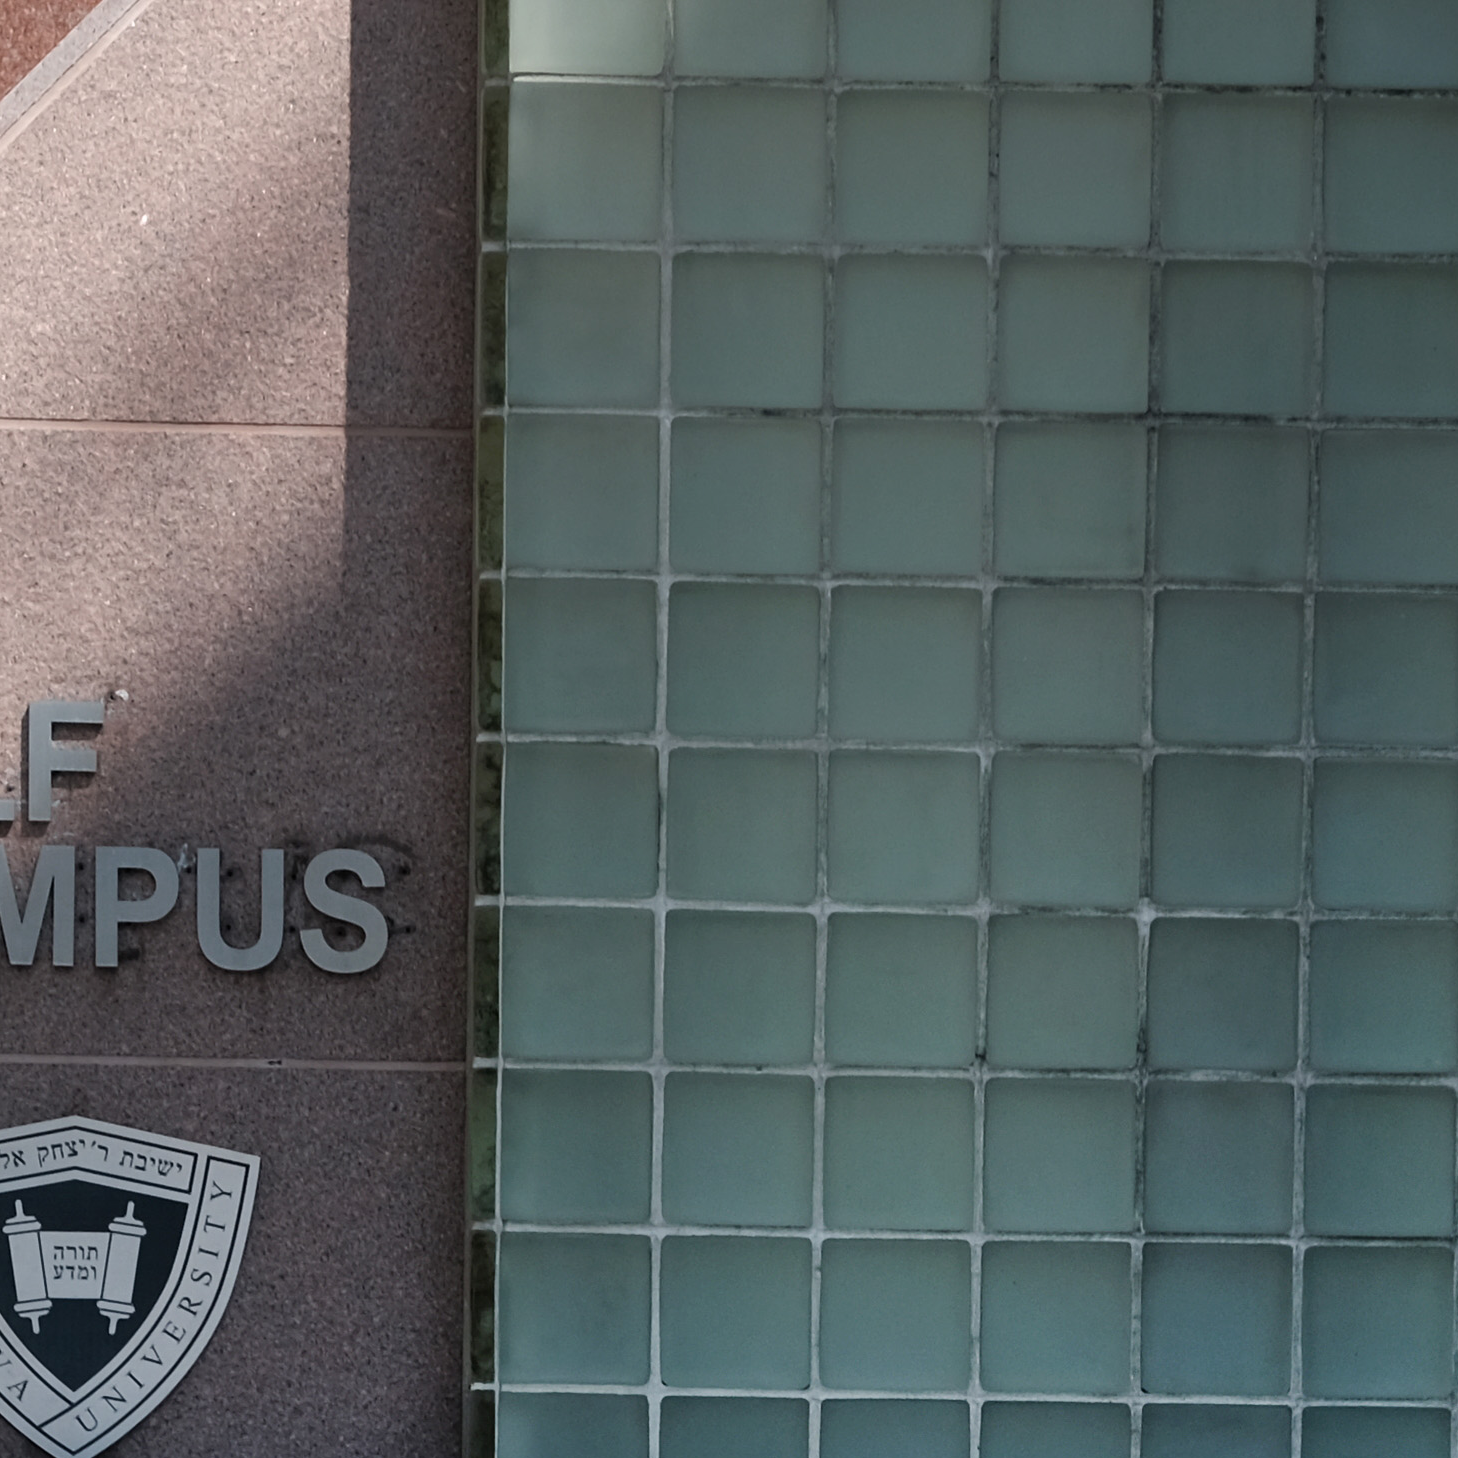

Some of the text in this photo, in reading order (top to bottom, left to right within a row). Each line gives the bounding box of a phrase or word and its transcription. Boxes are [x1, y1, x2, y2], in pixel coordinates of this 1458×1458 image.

[36, 1138, 87, 1168] יצחק
[118, 1149, 183, 1177] ישיבת
[53, 1245, 99, 1261] תורה
[53, 1264, 97, 1280] ומדע
[75, 1180, 234, 1434] UNIVERSITY
